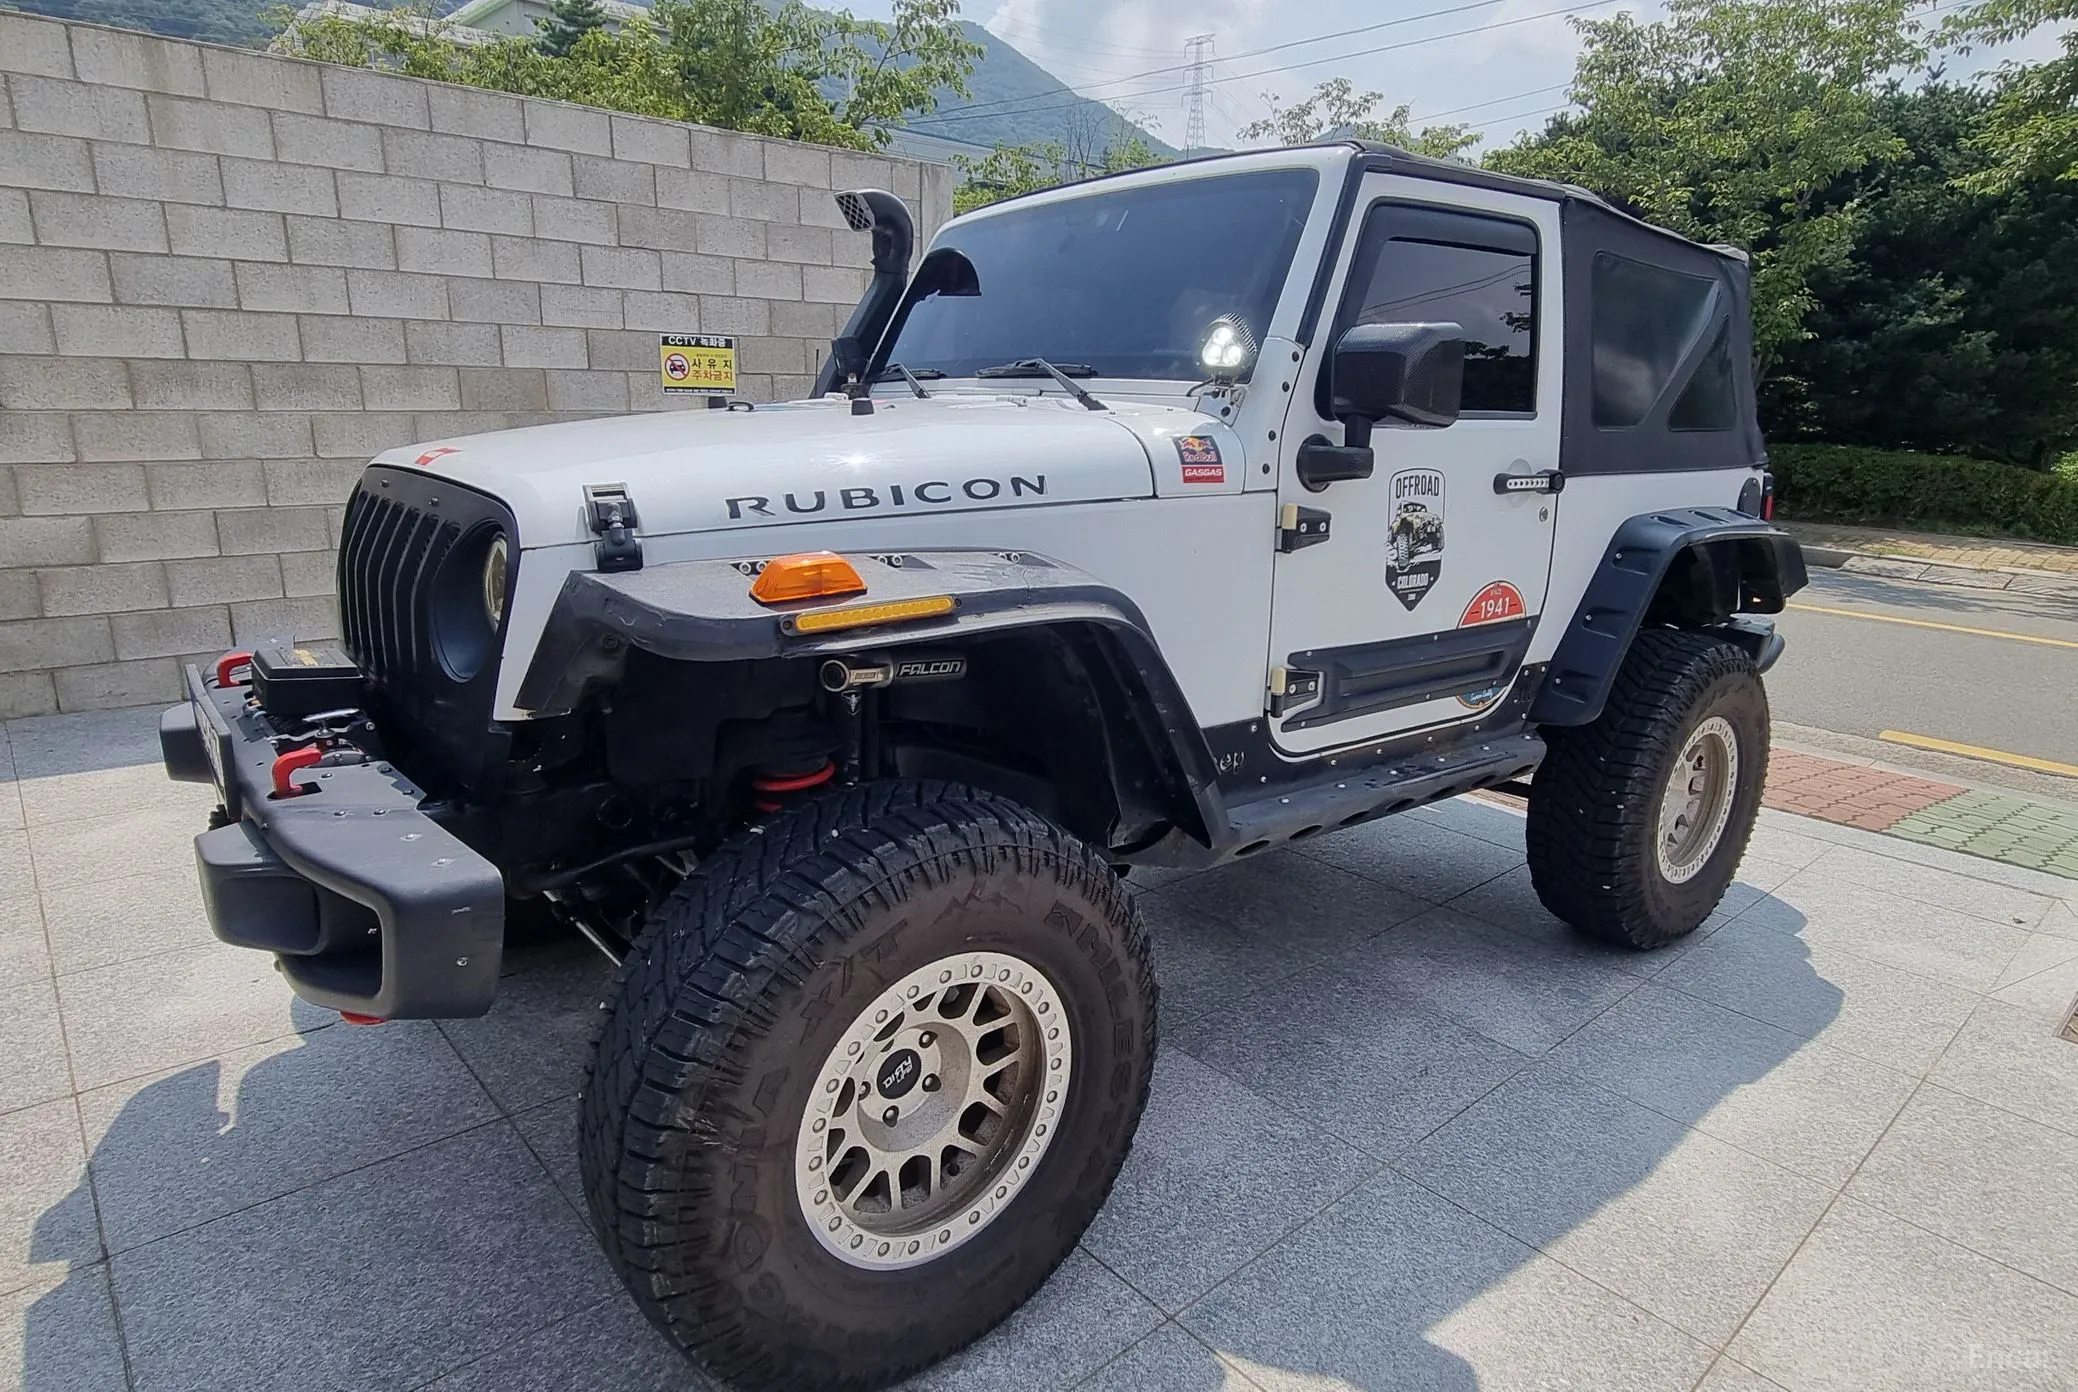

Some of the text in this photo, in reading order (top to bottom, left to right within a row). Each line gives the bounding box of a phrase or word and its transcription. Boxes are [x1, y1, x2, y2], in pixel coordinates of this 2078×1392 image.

[668, 336, 696, 345] CCTV
[692, 370, 732, 381] 주차금지
[1184, 468, 1223, 477] GASGAS
[1395, 474, 1440, 500] OFFROAD
[724, 474, 1048, 520] RUBICON
[1397, 572, 1429, 589] COLORADO
[1481, 596, 1510, 619] 1941
[899, 661, 961, 676] FALCON
[882, 1055, 912, 1089] DIRTY
